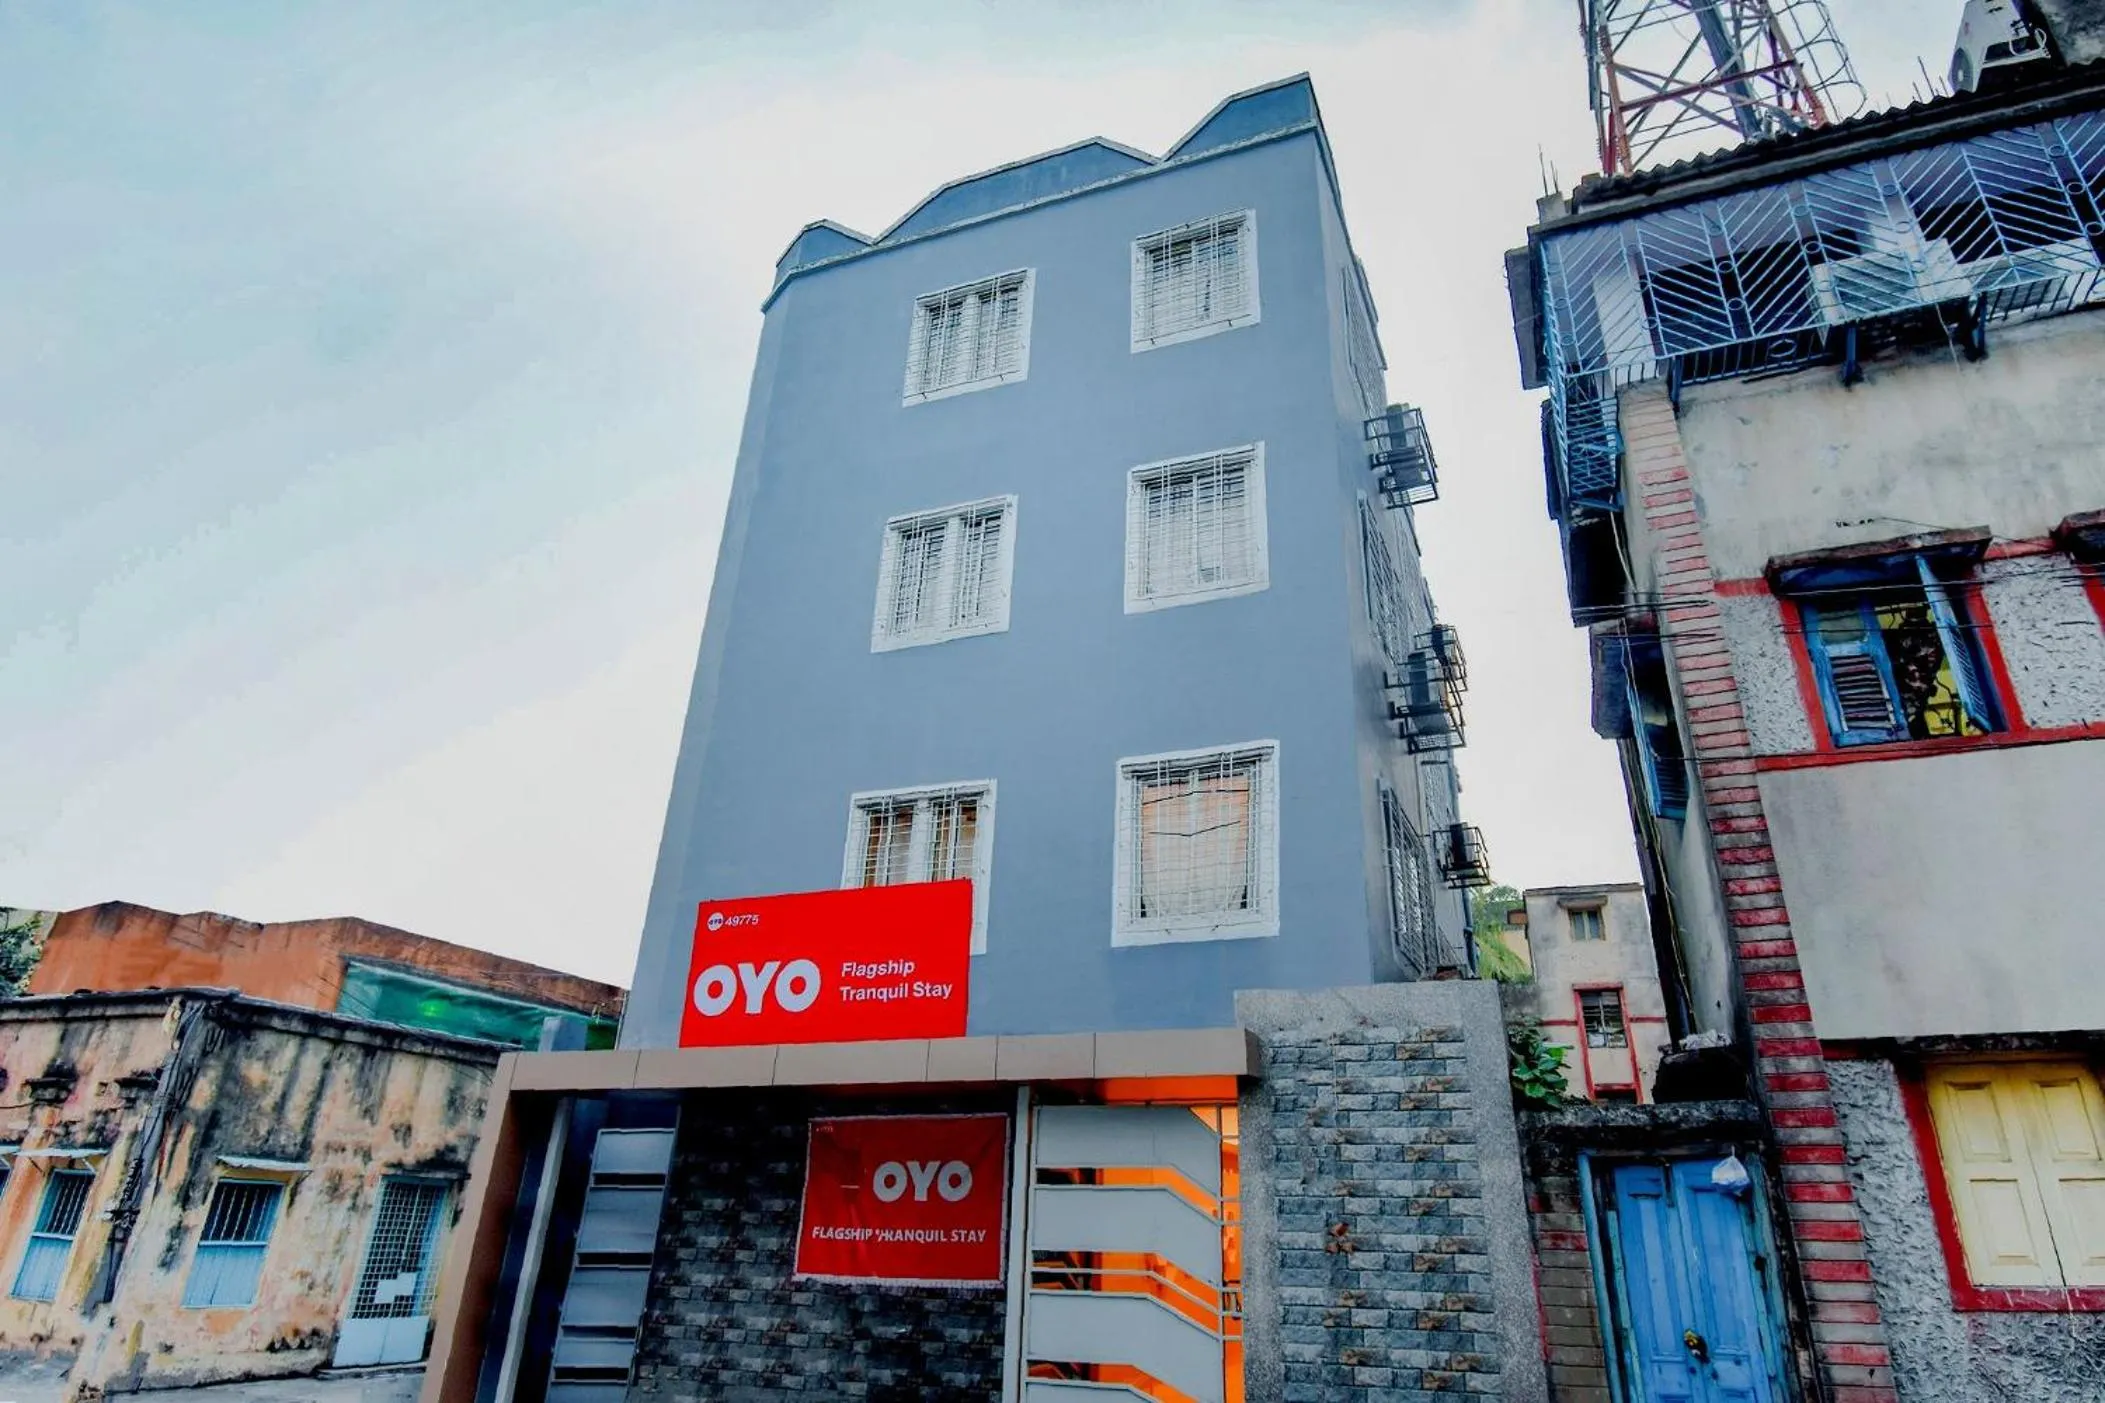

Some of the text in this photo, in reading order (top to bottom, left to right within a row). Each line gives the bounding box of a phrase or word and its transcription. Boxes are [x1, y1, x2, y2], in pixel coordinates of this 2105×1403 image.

[725, 914, 760, 927] 49775
[841, 959, 915, 979] Flagship
[694, 960, 821, 1016] OYO
[840, 981, 952, 1002] Tranquil Stay
[873, 1160, 972, 1202] OYO
[812, 1226, 872, 1241] FLAGSHIP
[951, 1229, 987, 1243] STAY
